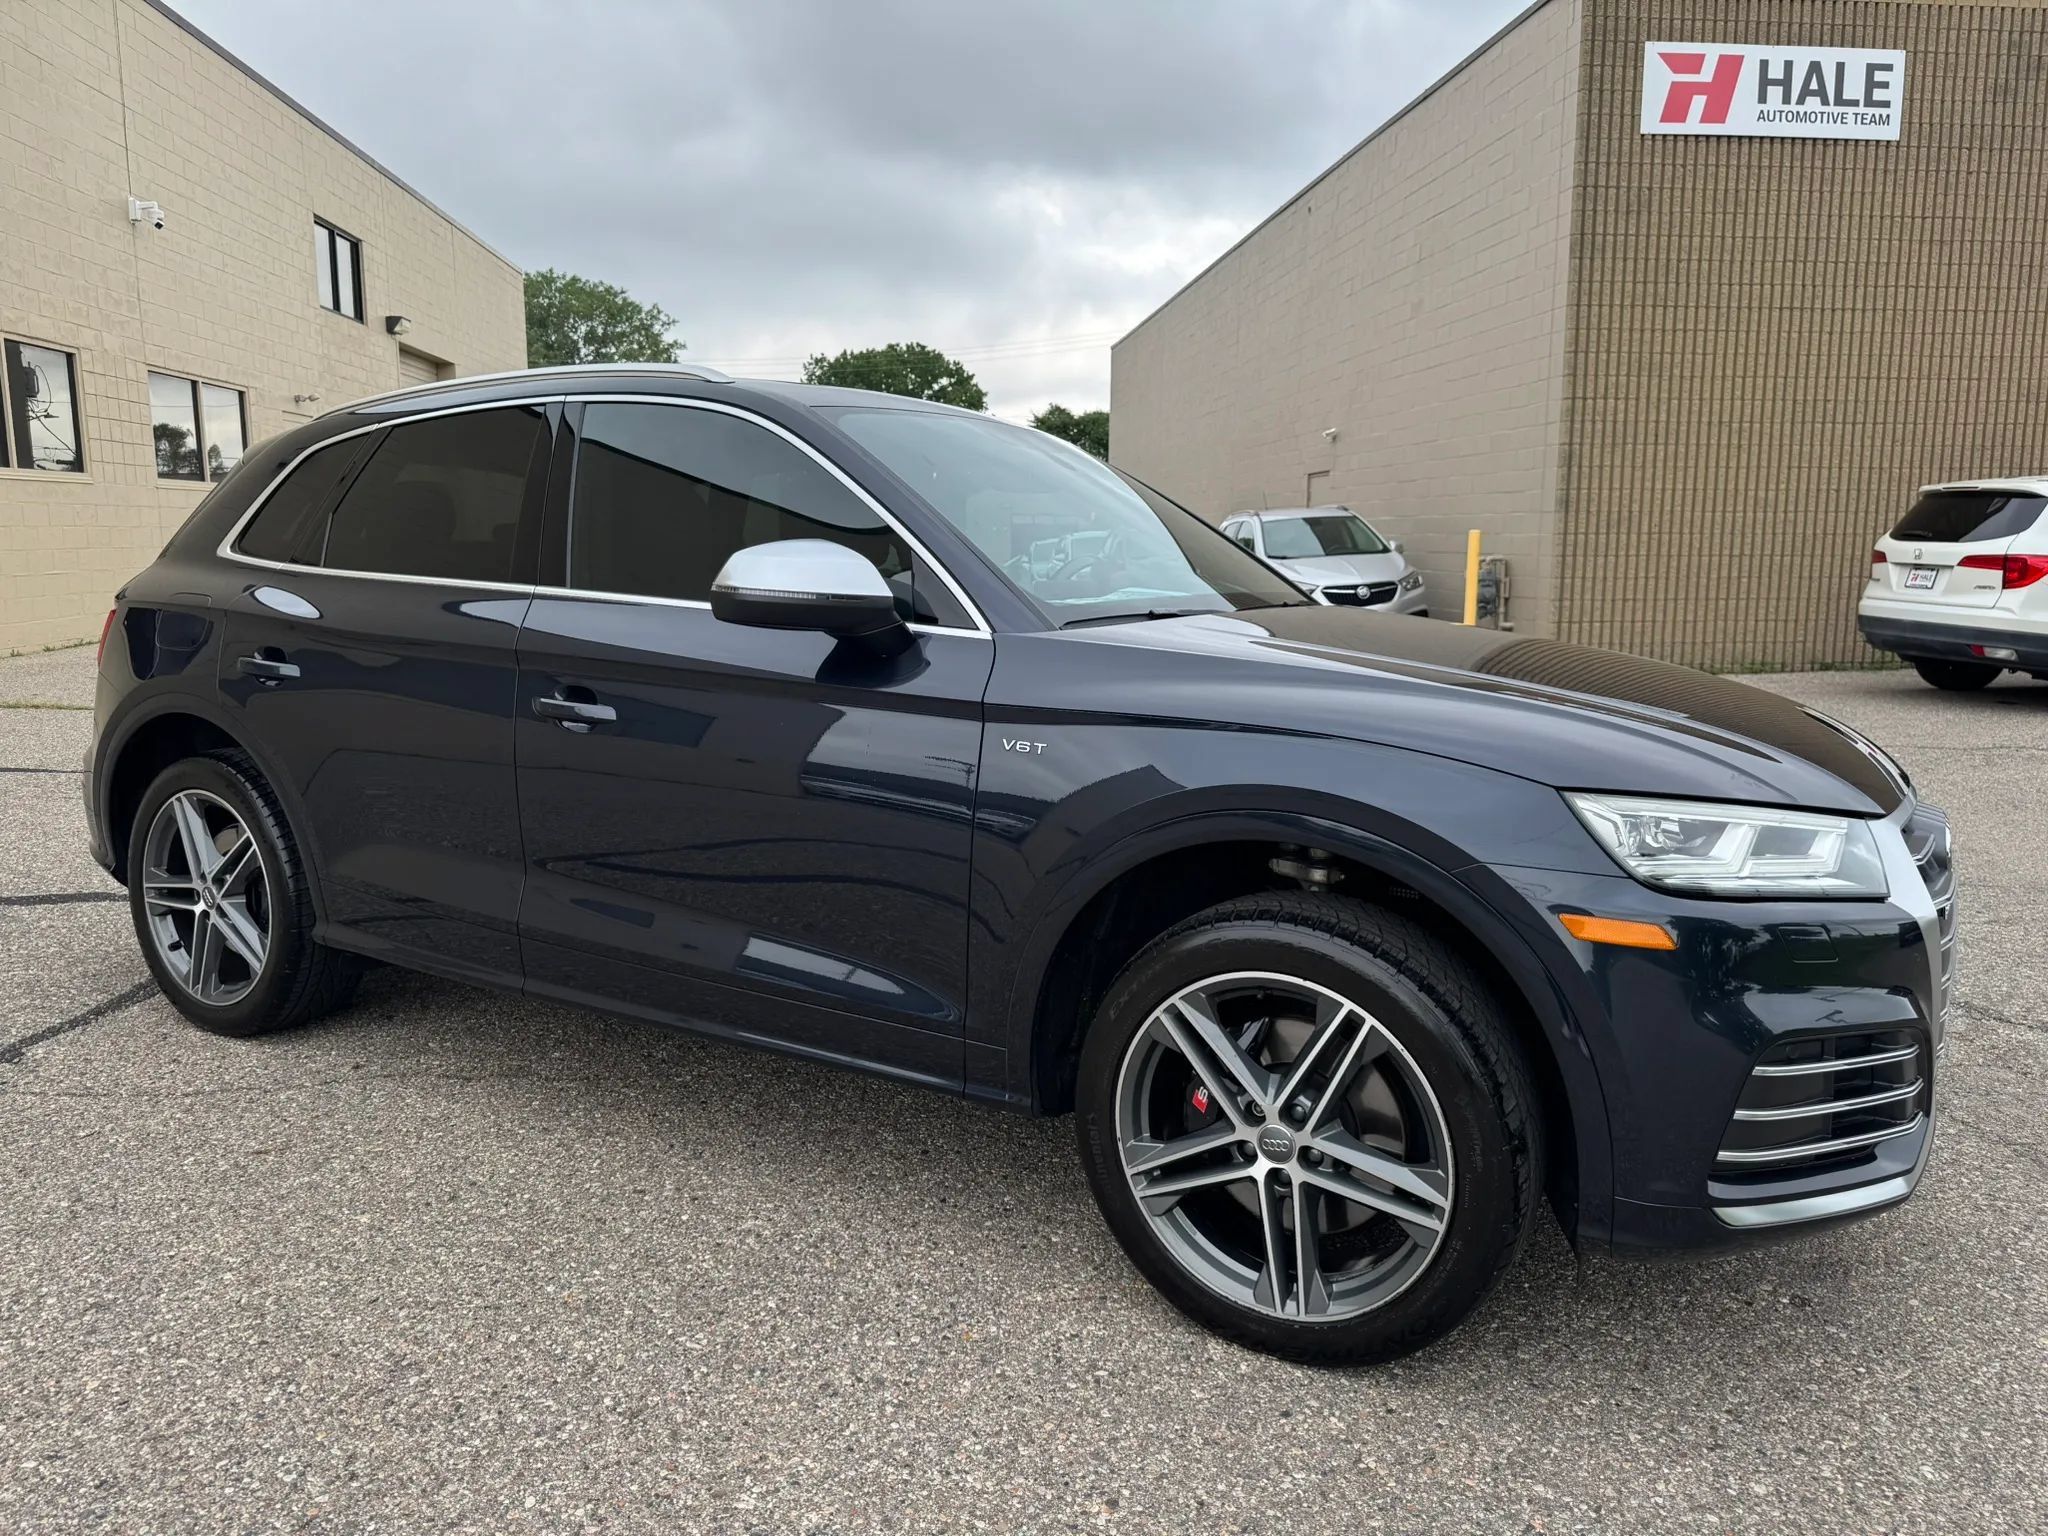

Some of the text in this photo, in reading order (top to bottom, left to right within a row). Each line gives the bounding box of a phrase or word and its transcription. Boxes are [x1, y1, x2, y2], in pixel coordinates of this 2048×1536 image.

[1757, 58, 1894, 109] HALE
[1756, 109, 1891, 127] AUTOMOTIVE TEAM
[1002, 738, 1047, 755] V6T
